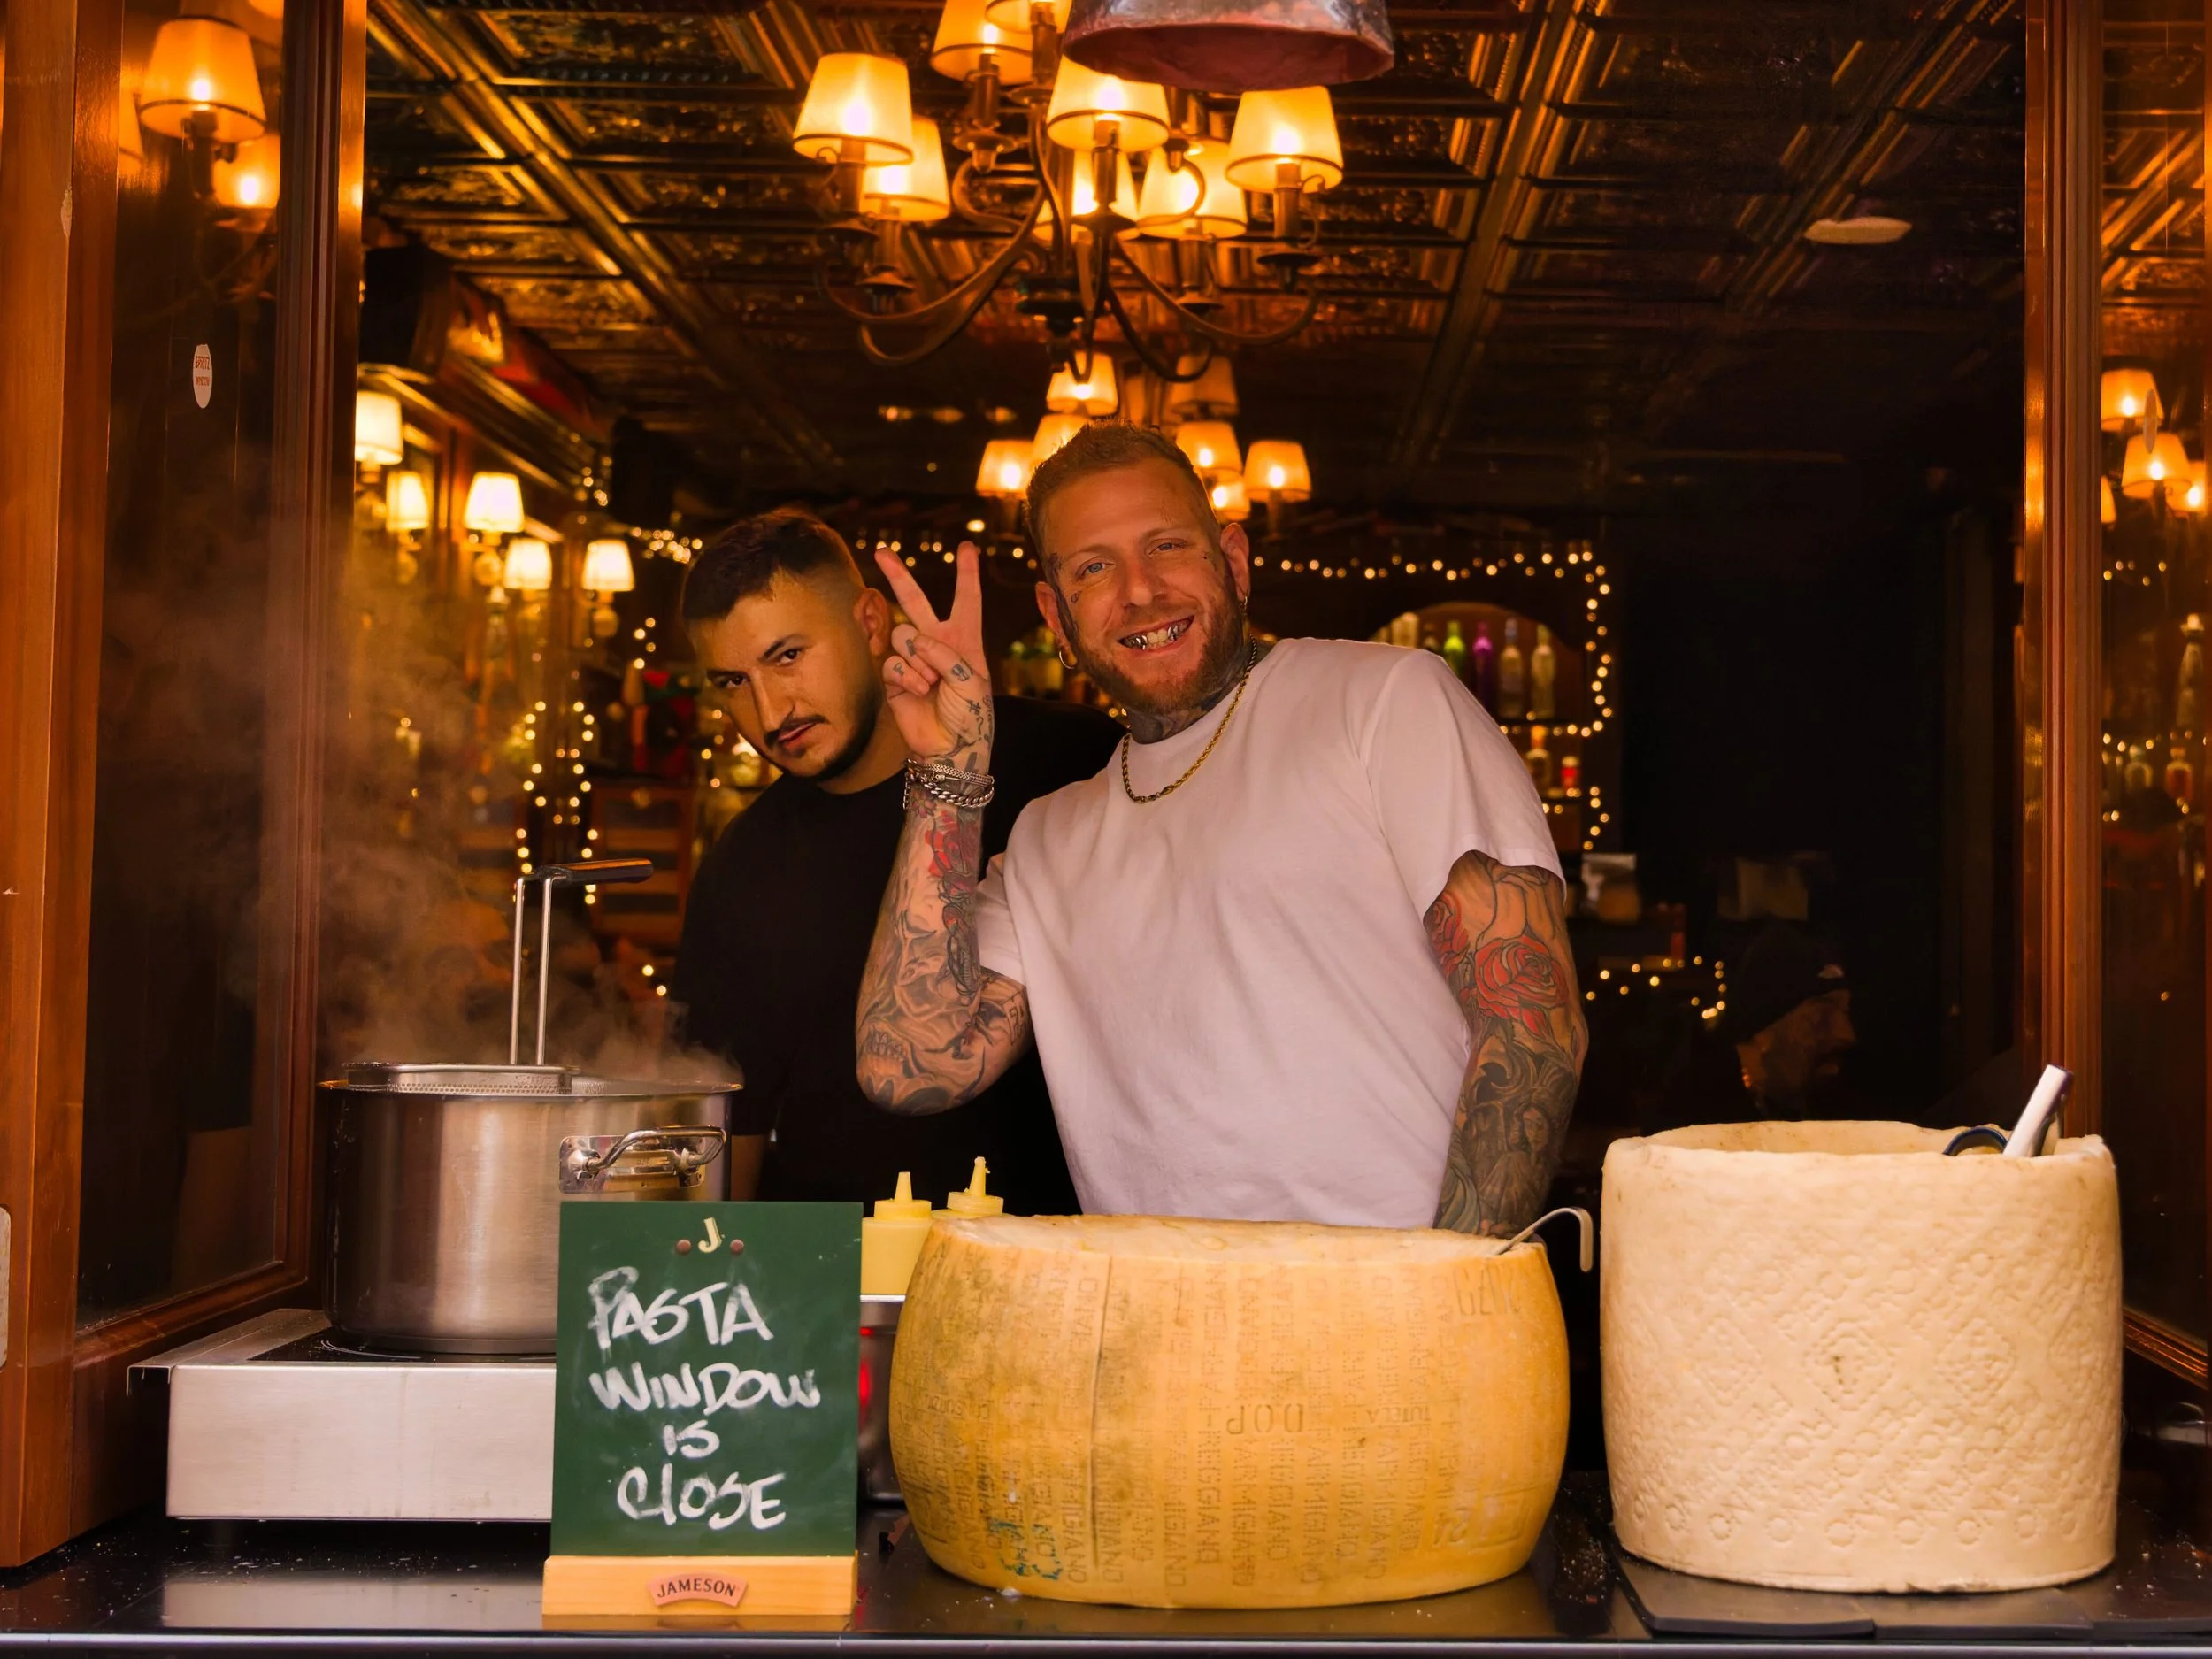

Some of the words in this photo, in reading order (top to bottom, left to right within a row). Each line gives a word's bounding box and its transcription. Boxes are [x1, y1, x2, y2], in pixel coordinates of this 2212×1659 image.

[697, 1217, 722, 1253] J
[588, 1266, 774, 1350] PASTA
[588, 1362, 821, 1415] WINDOW
[663, 1419, 720, 1458] IS
[657, 1578, 737, 1598] JAMESON
